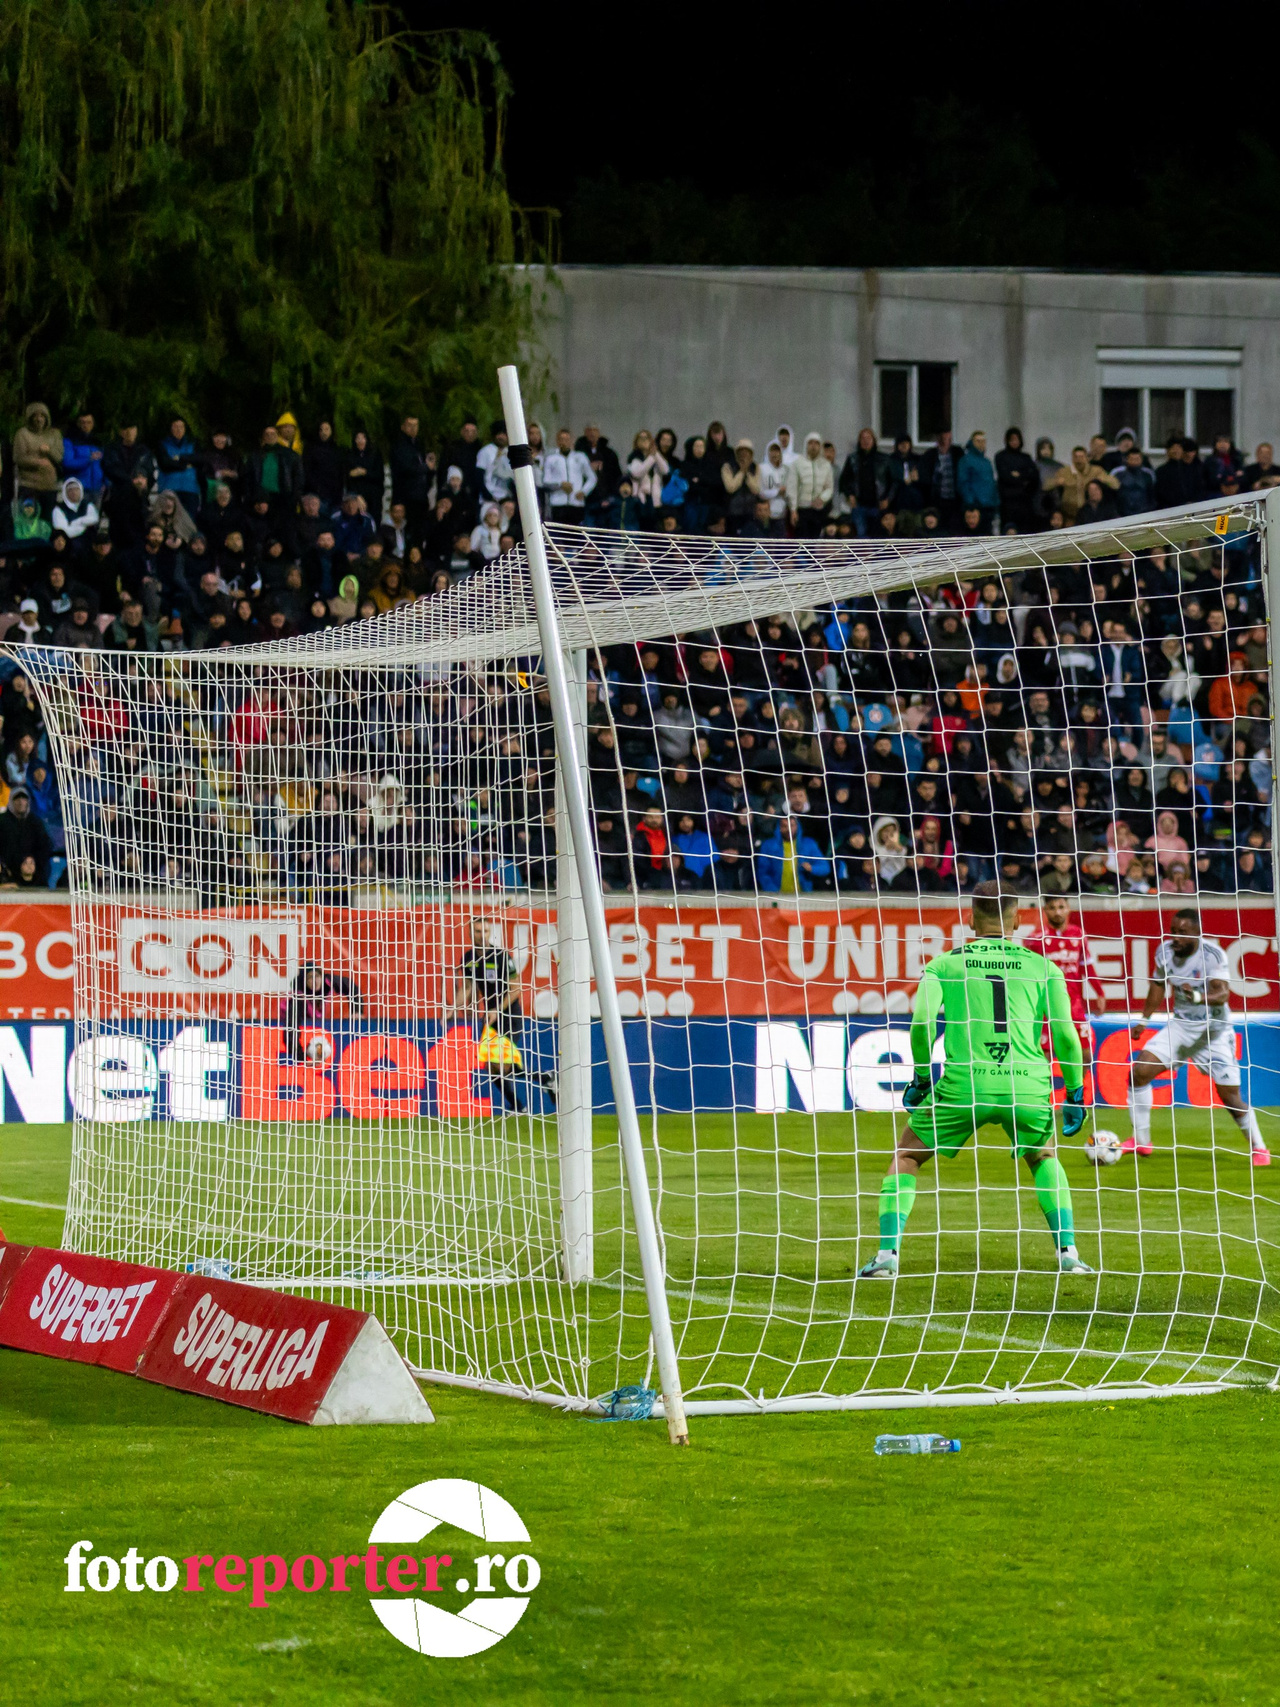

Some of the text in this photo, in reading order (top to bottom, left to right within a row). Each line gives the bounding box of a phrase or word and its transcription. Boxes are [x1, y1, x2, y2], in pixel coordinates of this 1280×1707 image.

[488, 923, 742, 979] UNBET
[965, 959, 1022, 970] GOLUBOVIC
[985, 974, 1008, 1034] 1
[0, 1025, 491, 1123] NetBet
[756, 1020, 1242, 1114] Nee
[990, 1069, 1029, 1077] GAMING
[29, 1263, 157, 1344] SUPERBET
[173, 1292, 330, 1391] SUPERLIGA
